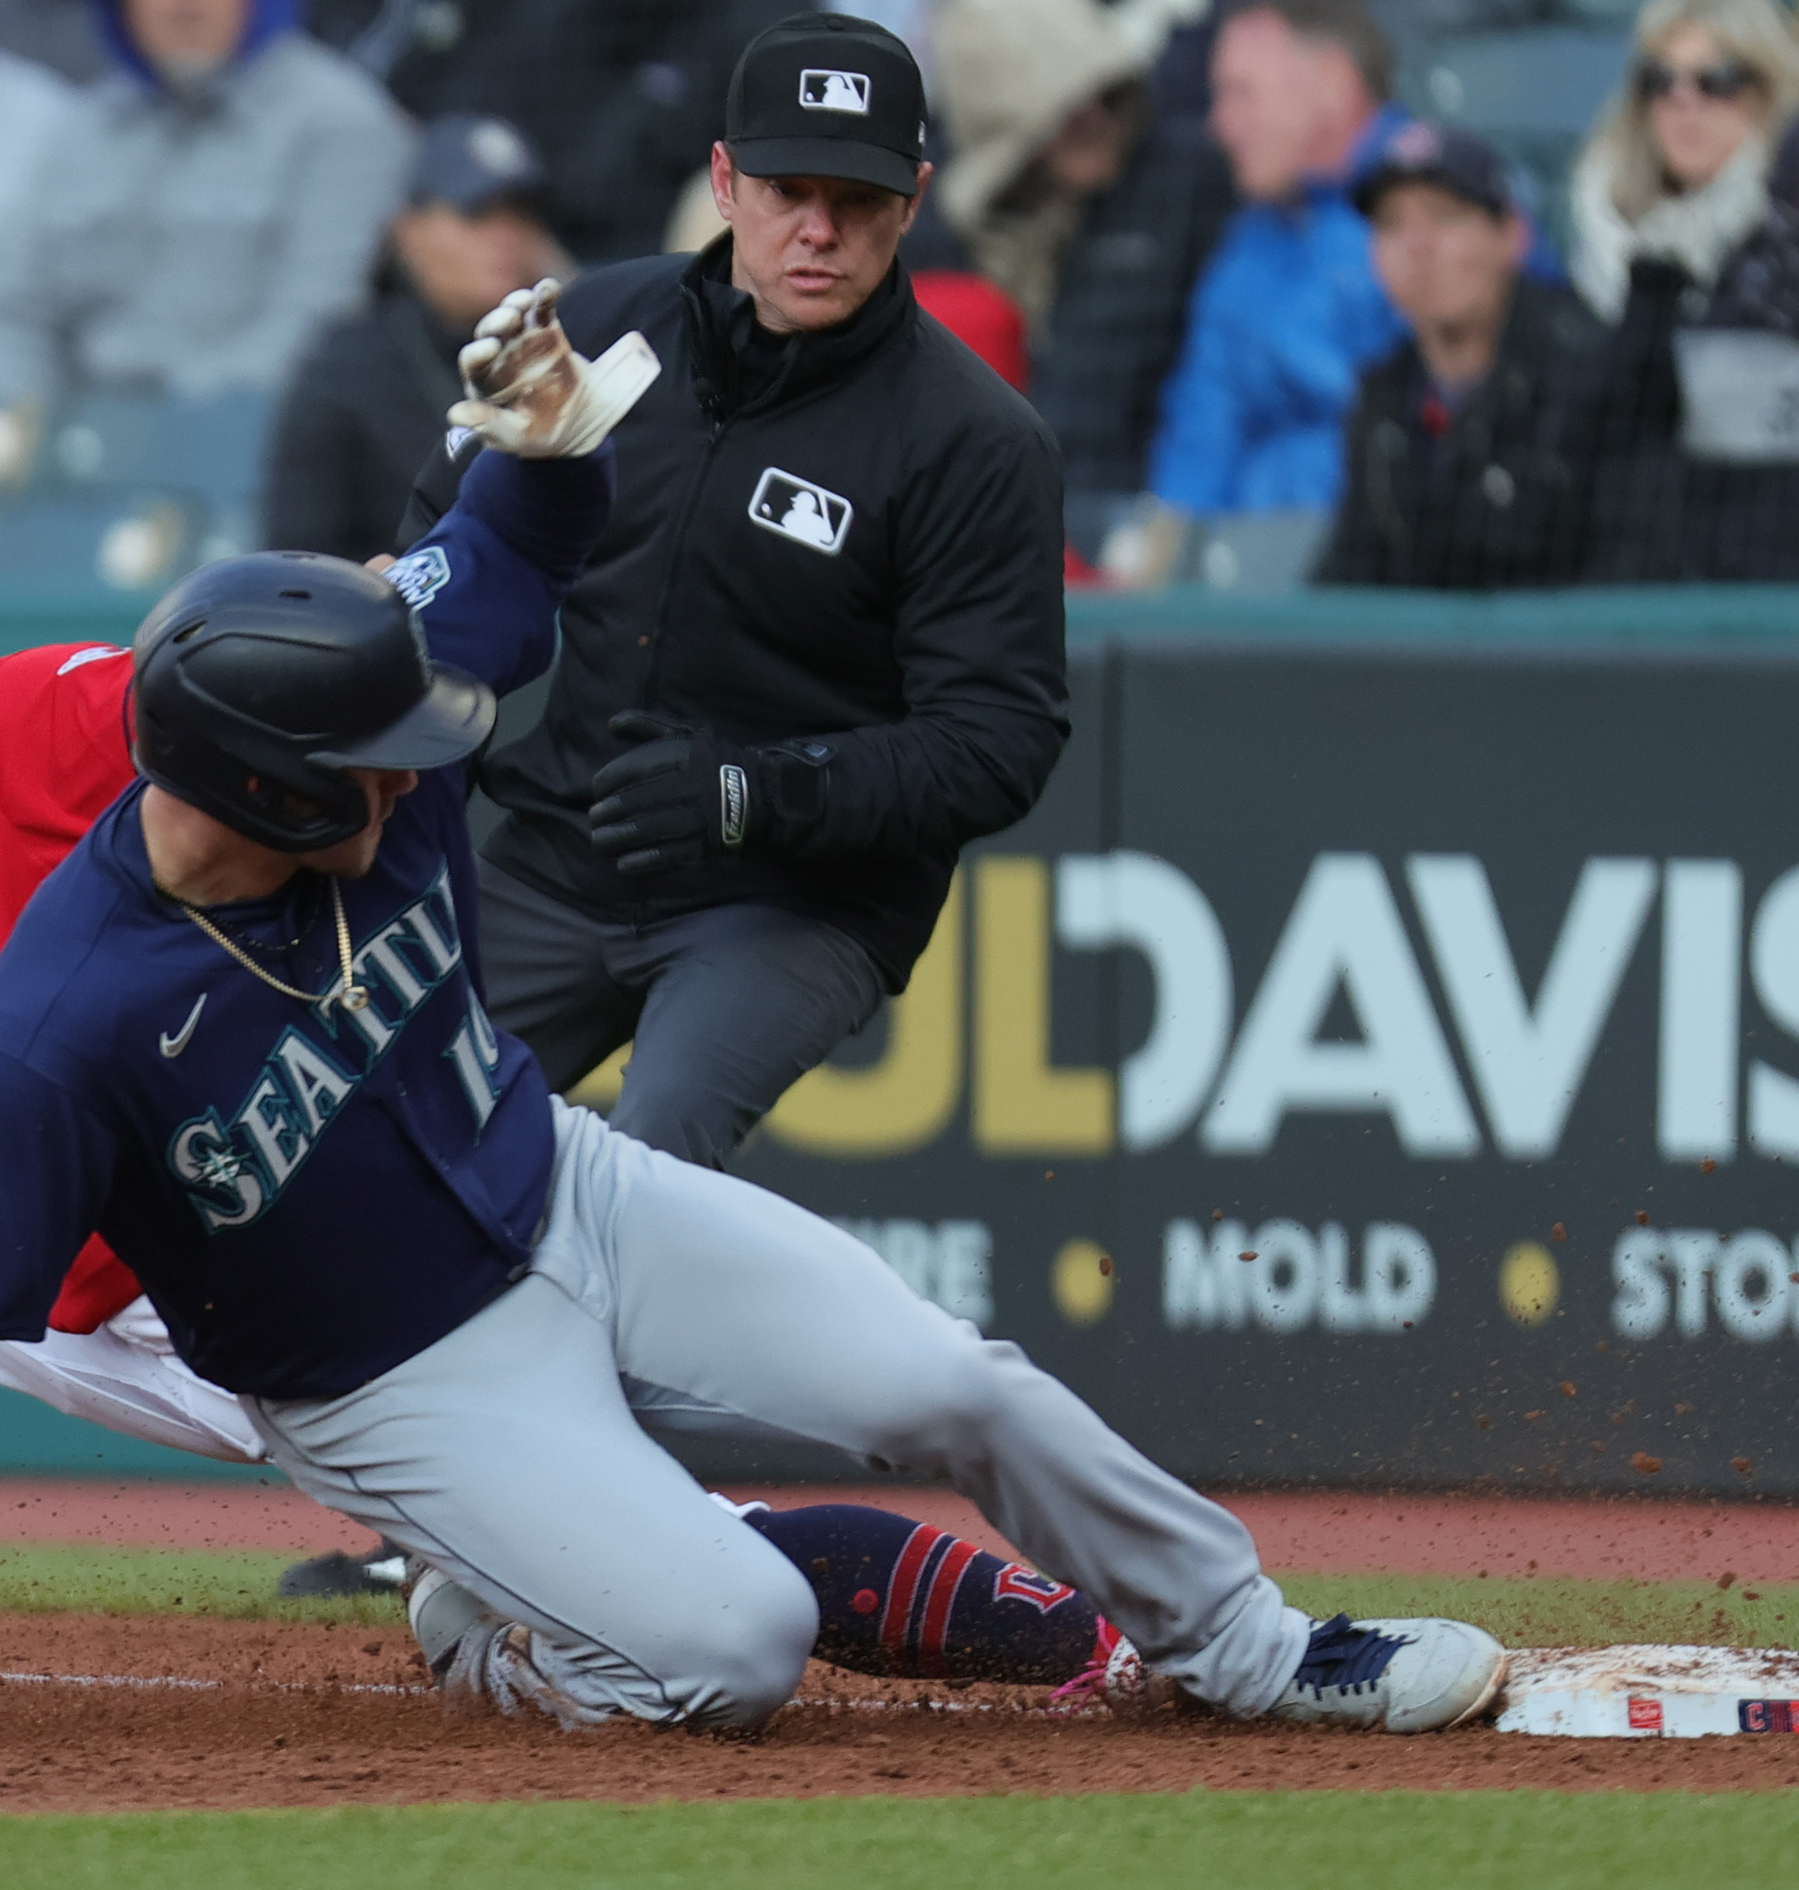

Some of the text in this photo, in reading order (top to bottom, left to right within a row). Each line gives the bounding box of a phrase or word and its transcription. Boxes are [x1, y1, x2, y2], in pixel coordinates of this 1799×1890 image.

[724, 767, 744, 840] Franklin
[167, 857, 463, 1235] SEATTL
[1161, 1217, 1438, 1333] MOLD
[1610, 1226, 1799, 1340] STO
[1745, 1701, 1767, 1732] C
